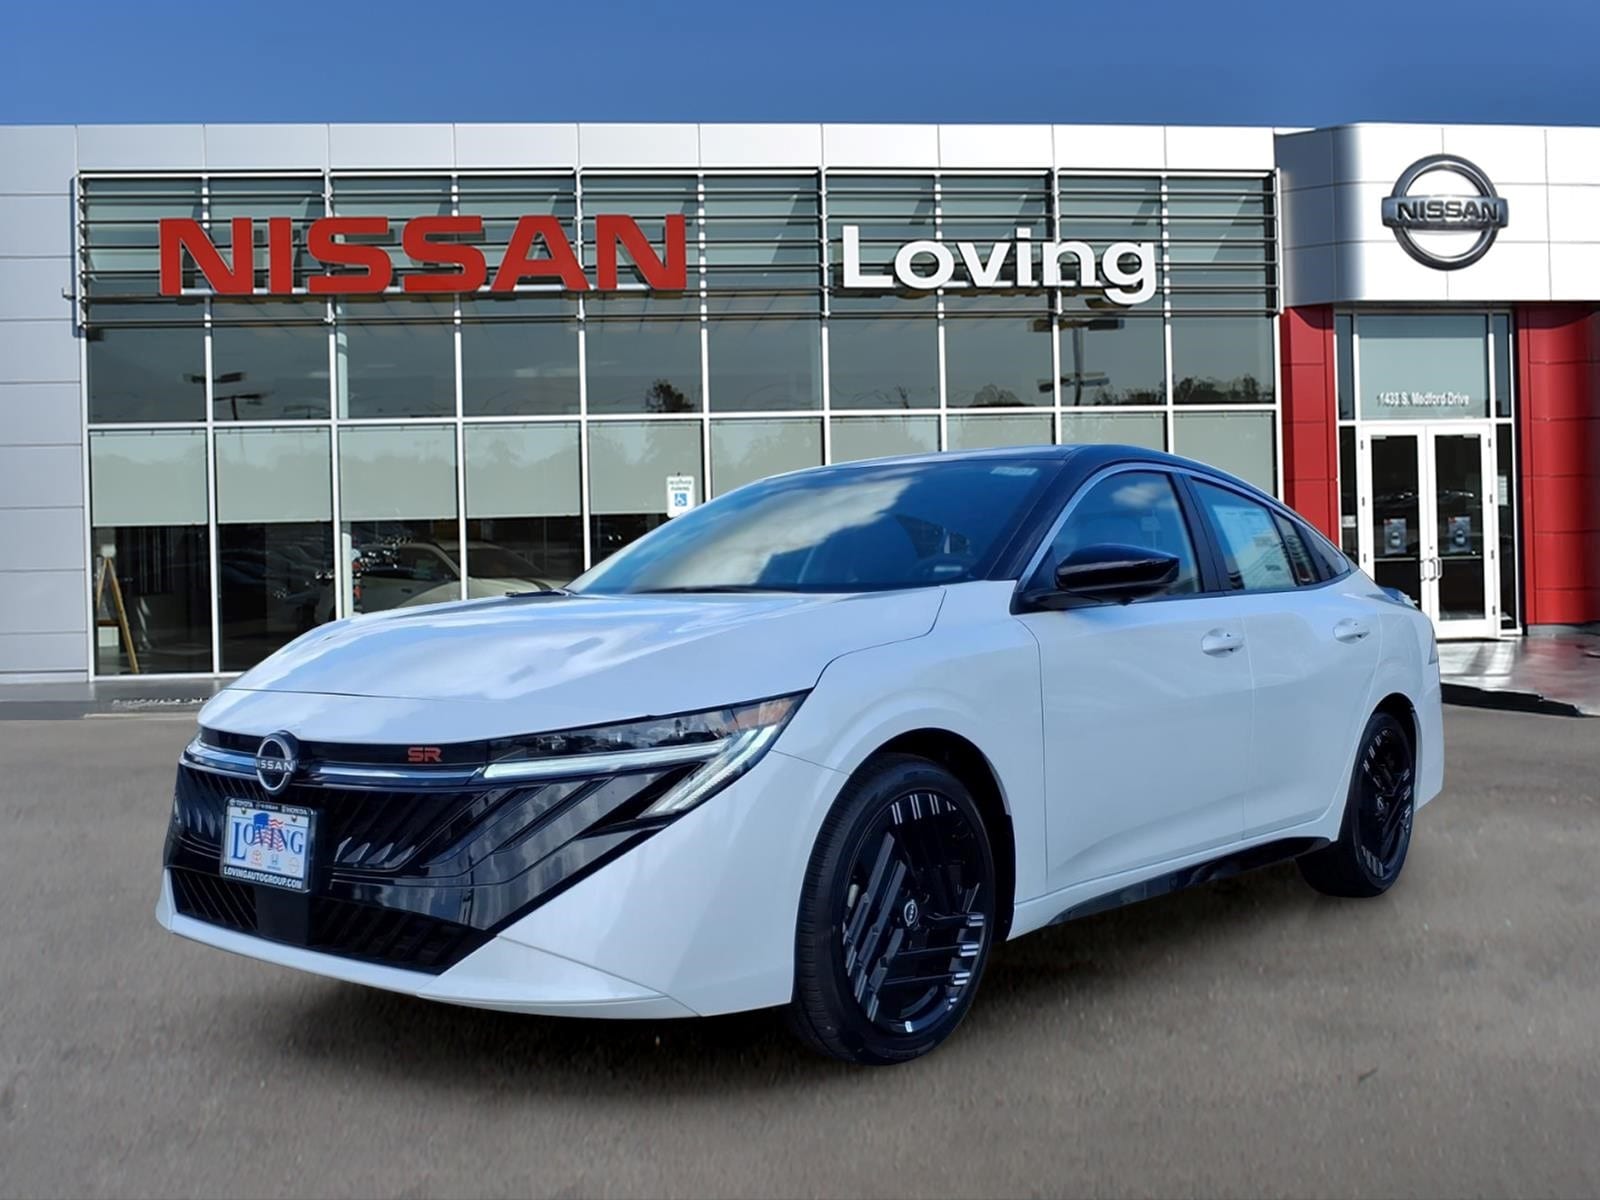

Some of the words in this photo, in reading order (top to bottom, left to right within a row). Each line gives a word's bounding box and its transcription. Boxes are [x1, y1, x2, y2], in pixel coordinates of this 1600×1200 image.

[1397, 200, 1498, 220] NISSAN
[159, 214, 687, 295] NISSAN
[842, 225, 1157, 305] Loving
[1447, 391, 1470, 406] Drive
[407, 747, 442, 762] SR
[231, 821, 304, 860] LOVING
[223, 866, 303, 889] LOVINGAUTOGROUP.COM
